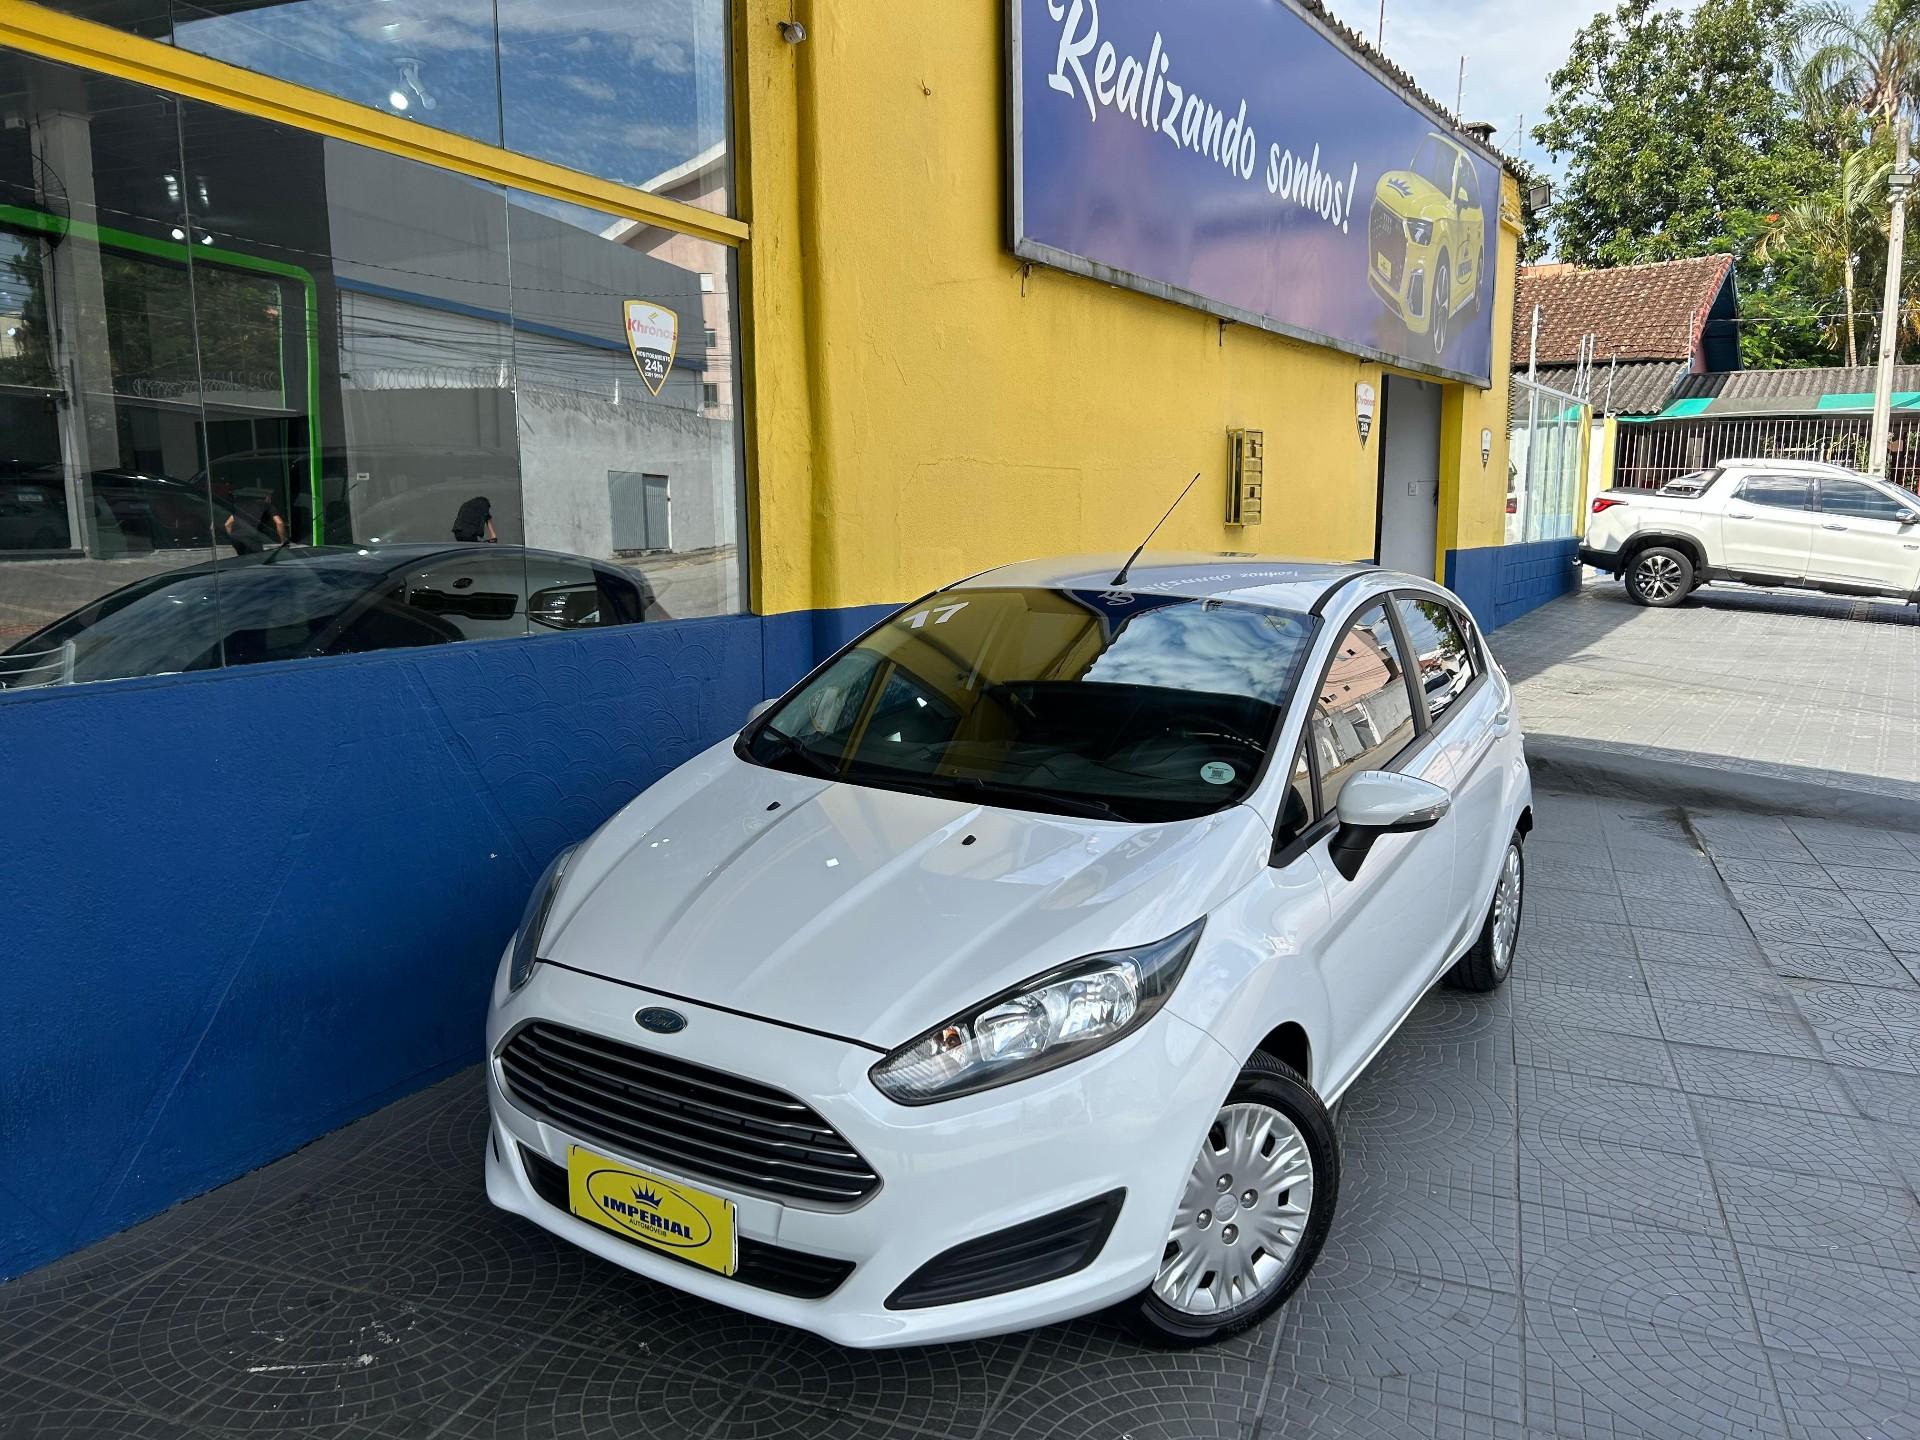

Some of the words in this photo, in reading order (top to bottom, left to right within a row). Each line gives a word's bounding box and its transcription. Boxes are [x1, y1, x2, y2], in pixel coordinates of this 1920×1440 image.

[1047, 0, 1256, 180] Realizando
[1266, 142, 1358, 234] sonhos!
[644, 359, 664, 373] 24h
[903, 601, 970, 629] 17
[603, 1195, 693, 1241] IMPERIAL
